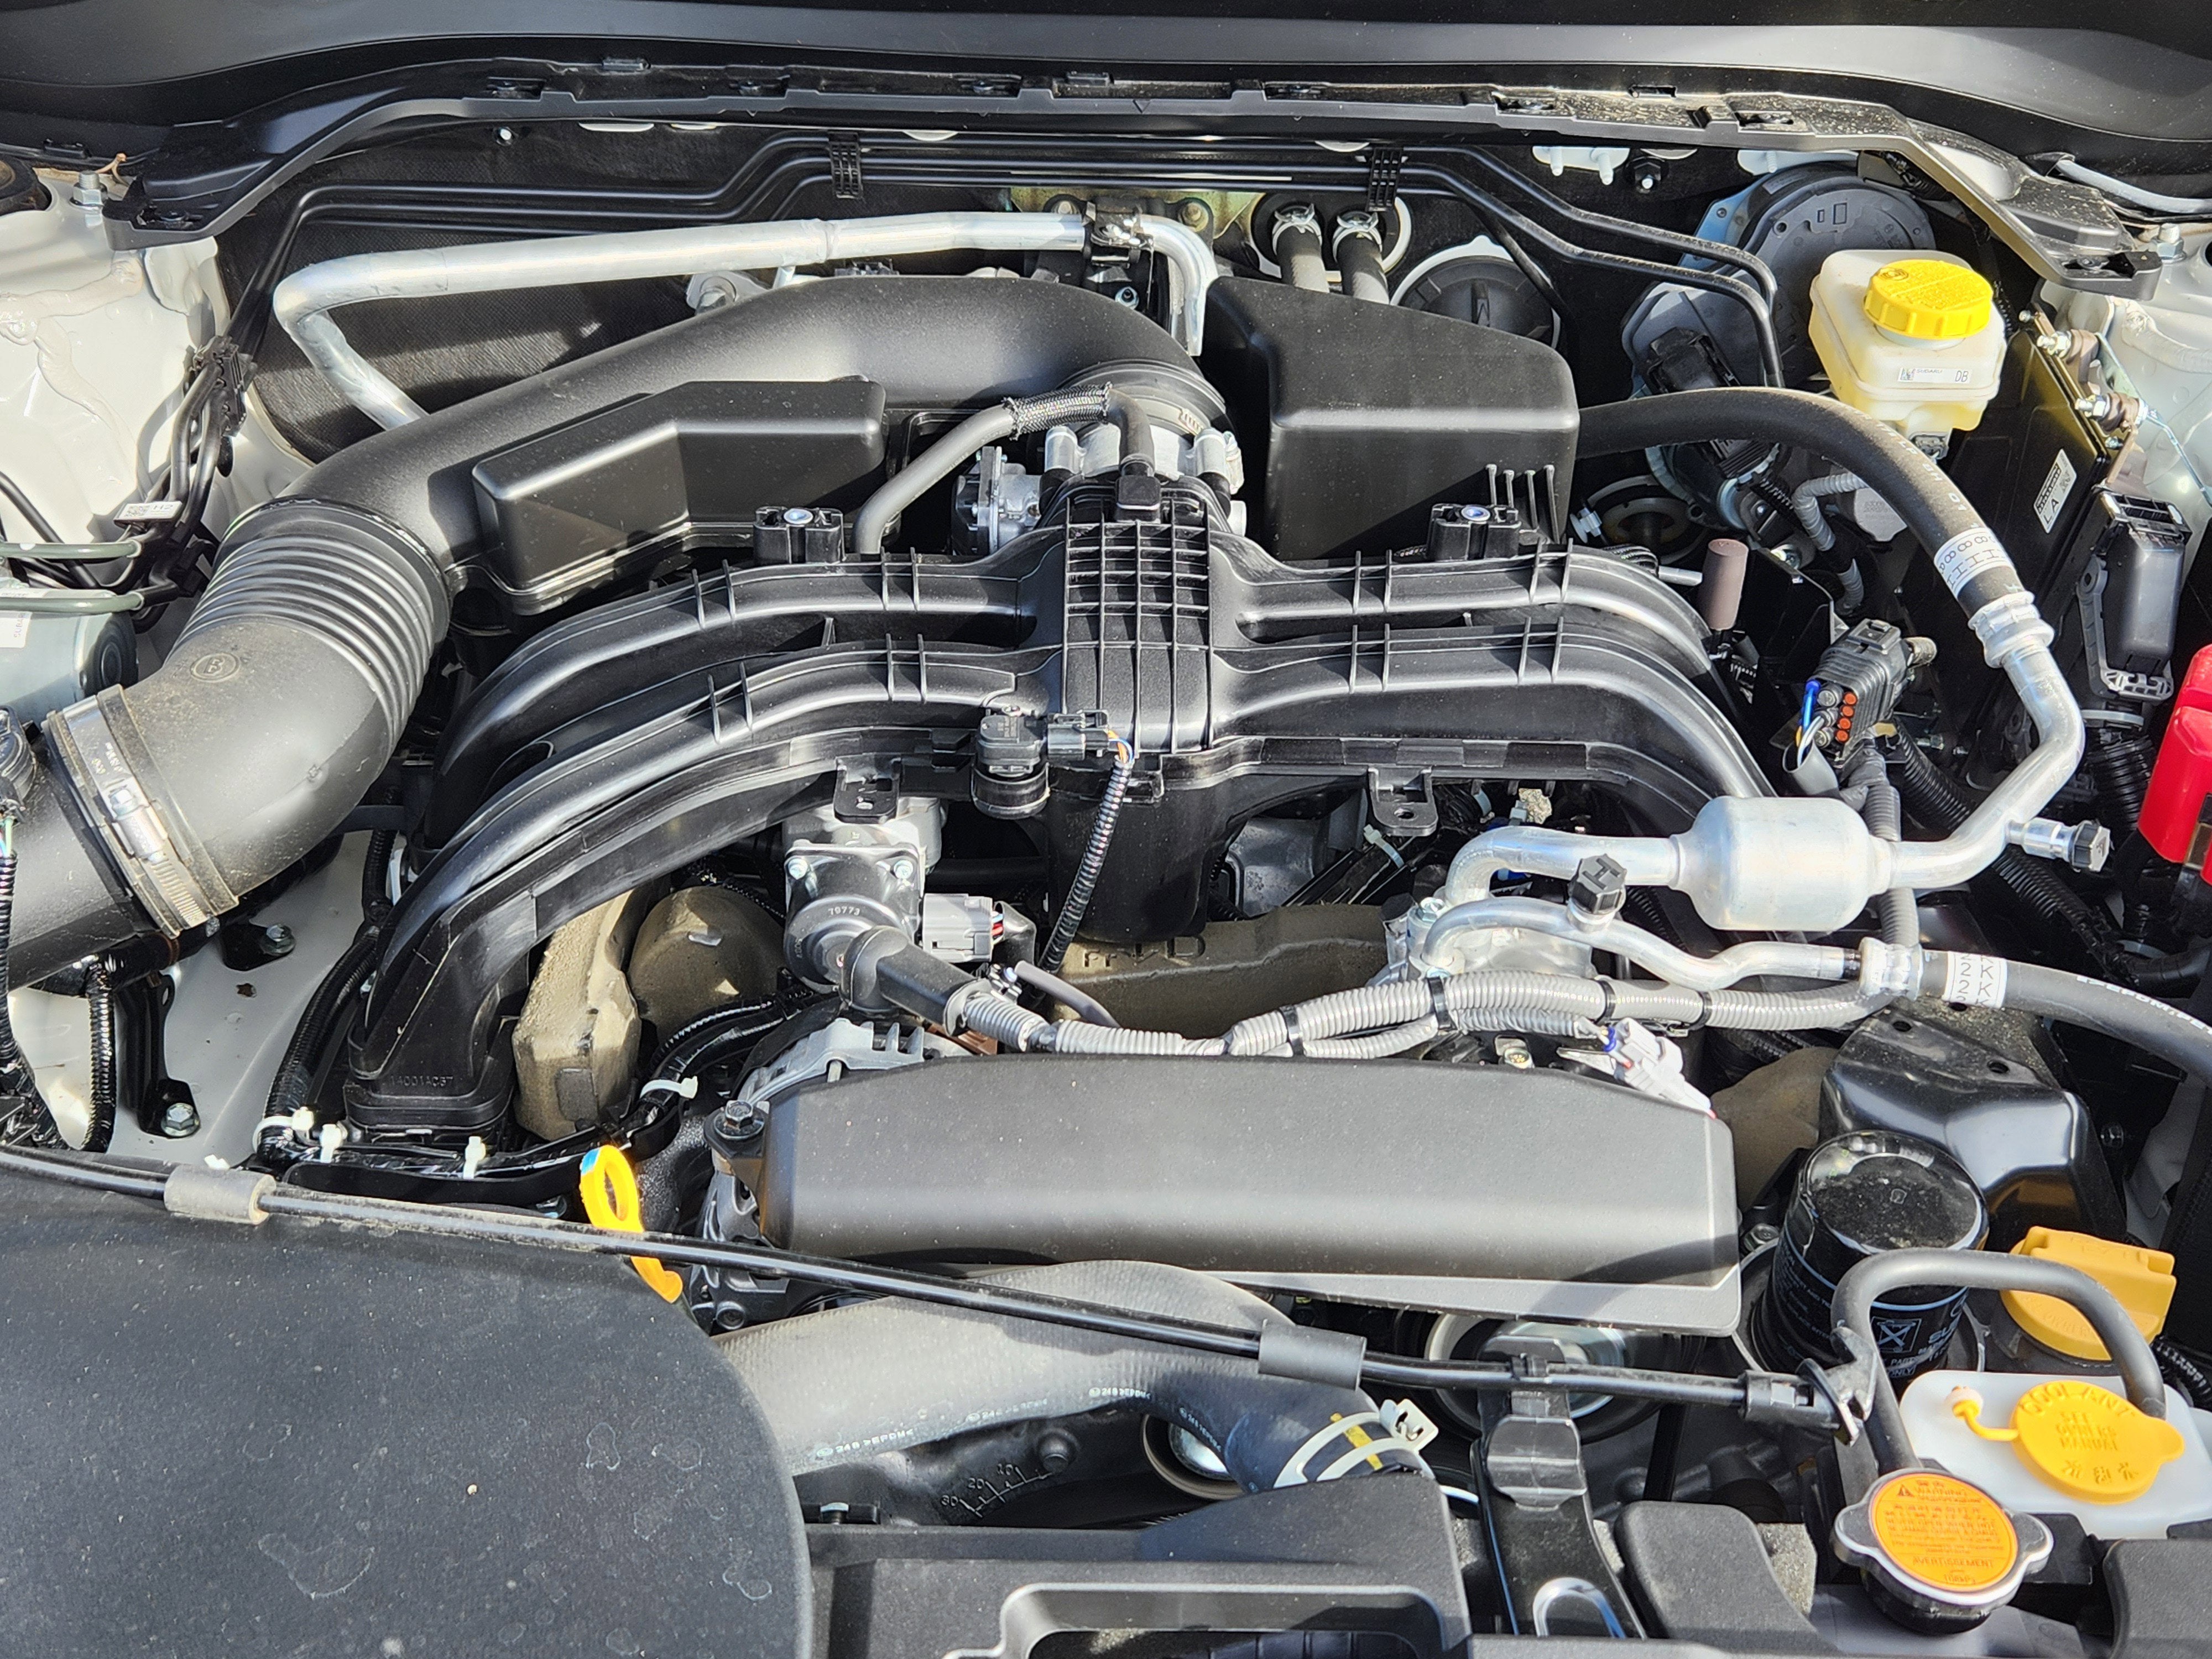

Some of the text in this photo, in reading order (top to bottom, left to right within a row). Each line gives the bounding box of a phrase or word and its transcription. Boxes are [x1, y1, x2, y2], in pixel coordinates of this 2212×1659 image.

[1582, 858, 1620, 890] H
[2019, 1382, 2136, 1417] COOLANT
[968, 1477, 985, 1490] 20
